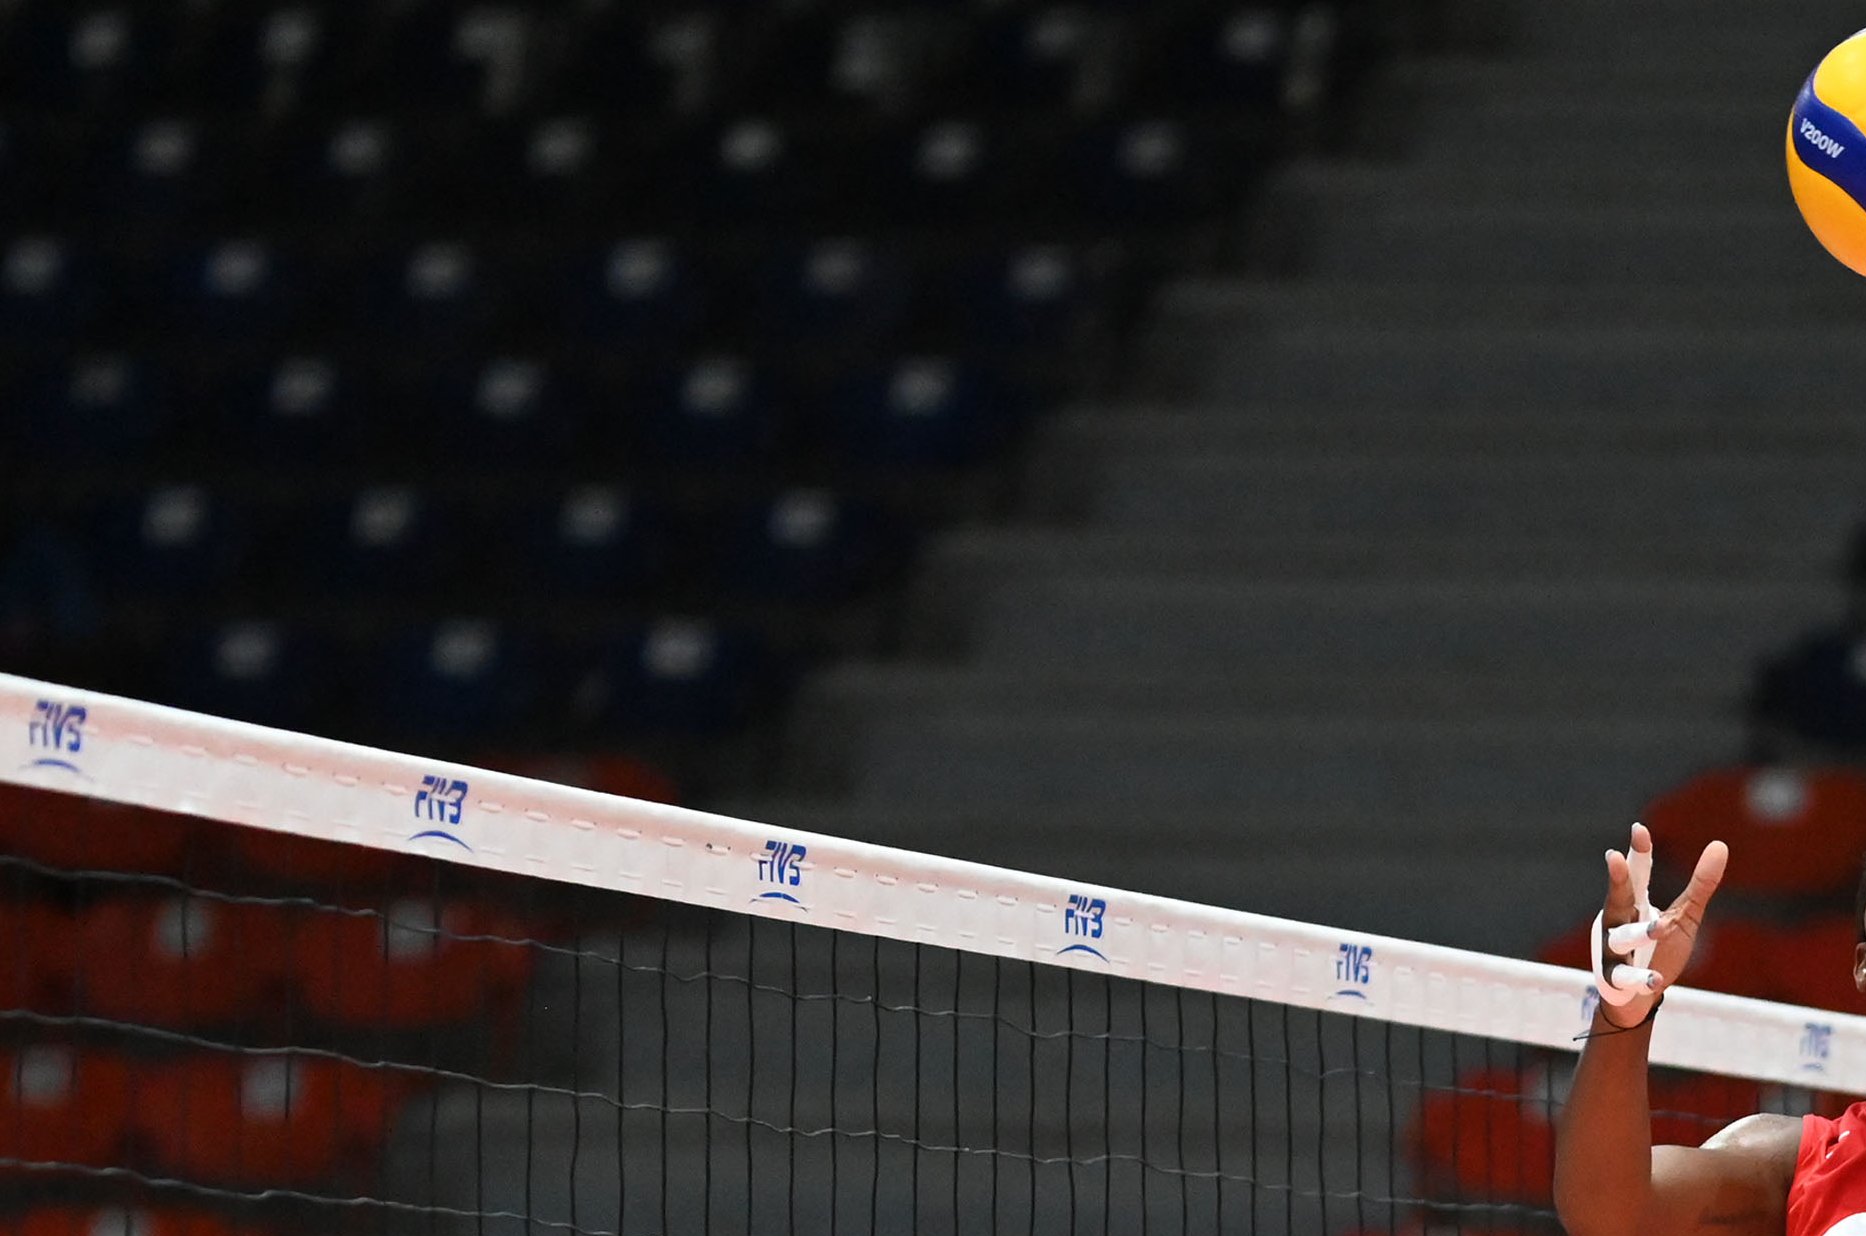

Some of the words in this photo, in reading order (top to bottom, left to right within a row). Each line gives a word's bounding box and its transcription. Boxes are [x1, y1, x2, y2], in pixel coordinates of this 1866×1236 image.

[1800, 118, 1845, 158] V200W
[415, 775, 468, 825] FIVB
[759, 840, 806, 886] FIVB
[1065, 894, 1106, 939] FIVB
